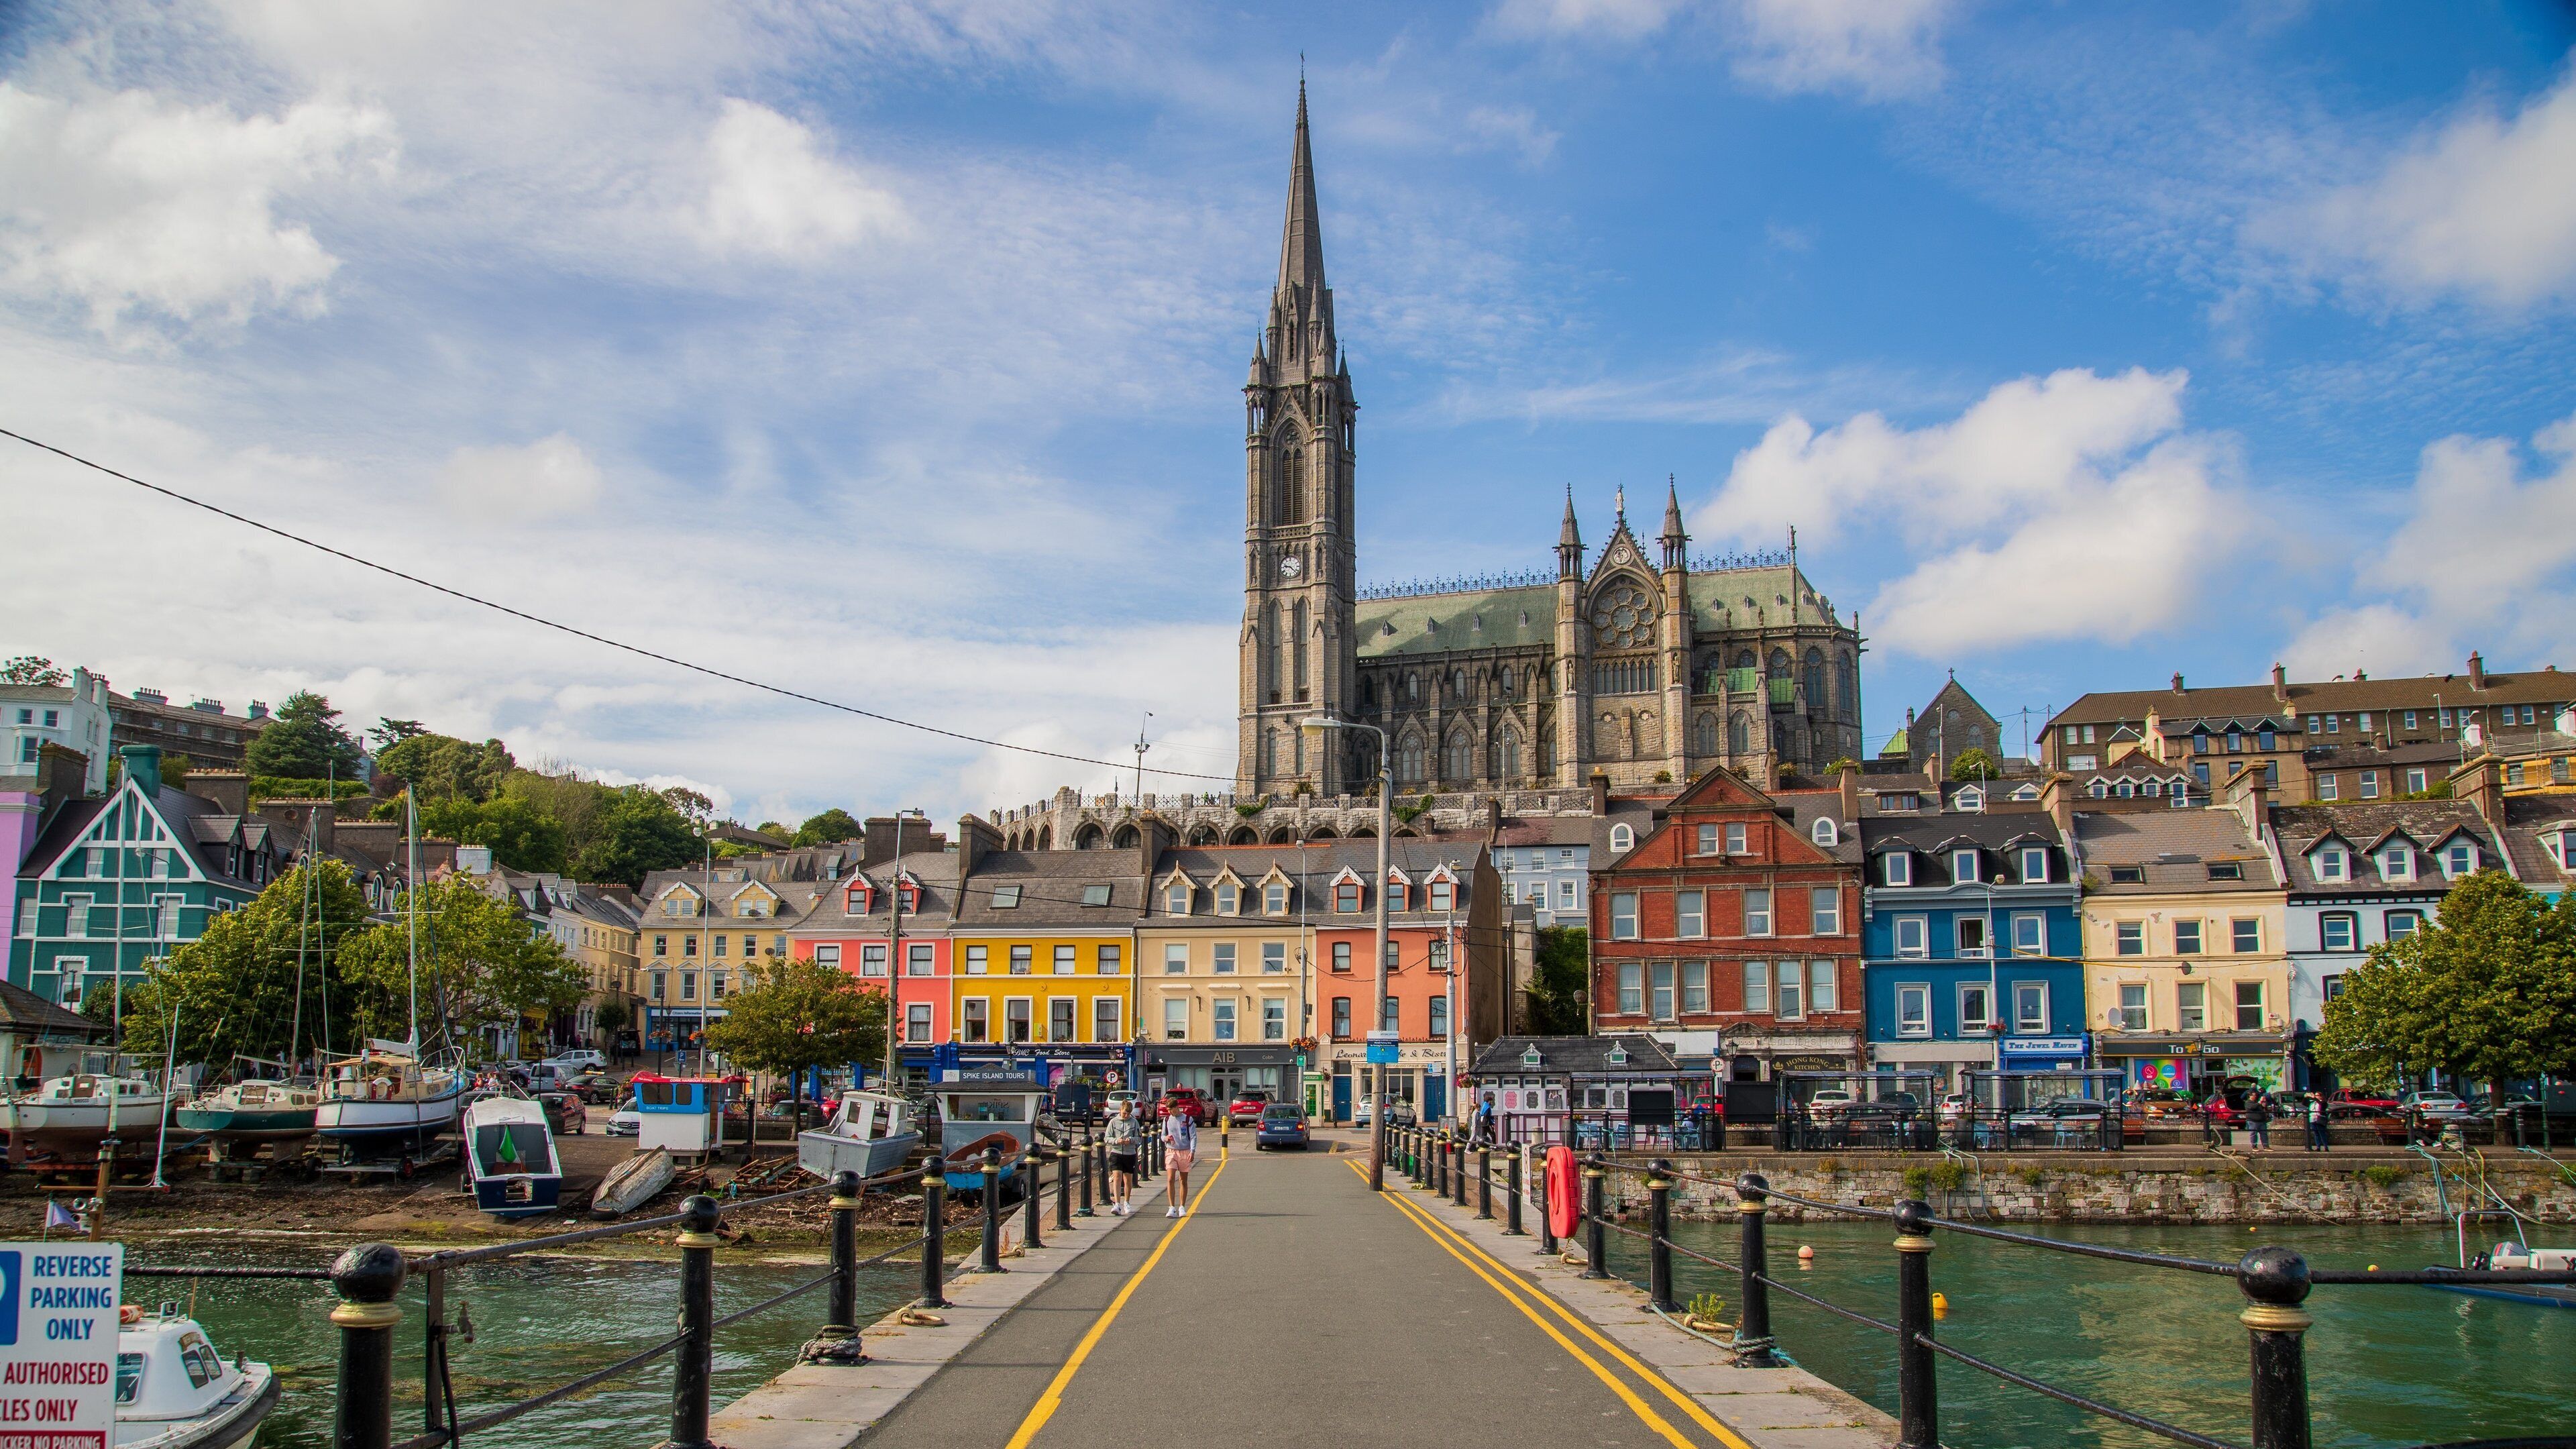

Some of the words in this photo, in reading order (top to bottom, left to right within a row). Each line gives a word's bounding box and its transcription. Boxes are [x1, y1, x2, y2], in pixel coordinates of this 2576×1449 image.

[1336, 1049, 1366, 1059] Leonar
[1422, 1049, 1446, 1058] Bistr
[2168, 1044, 2184, 1053] To
[2203, 1044, 2219, 1053] Go
[1213, 1052, 1236, 1063] AIB
[1786, 1057, 1807, 1067] HONG
[1809, 1057, 1829, 1068] KONG
[1715, 1061, 1720, 1069] P
[1110, 1073, 1115, 1081] P
[34, 1256, 113, 1277] REVERSE
[31, 1287, 111, 1308] PARKING
[46, 1318, 95, 1340] ONLY
[4, 1362, 108, 1385] AUTHORISED
[0, 1399, 30, 1421] LES
[36, 1399, 78, 1421] ONLY
[0, 1436, 32, 1449] ICKER
[34, 1436, 50, 1449] NO
[52, 1436, 101, 1449] PARKING
